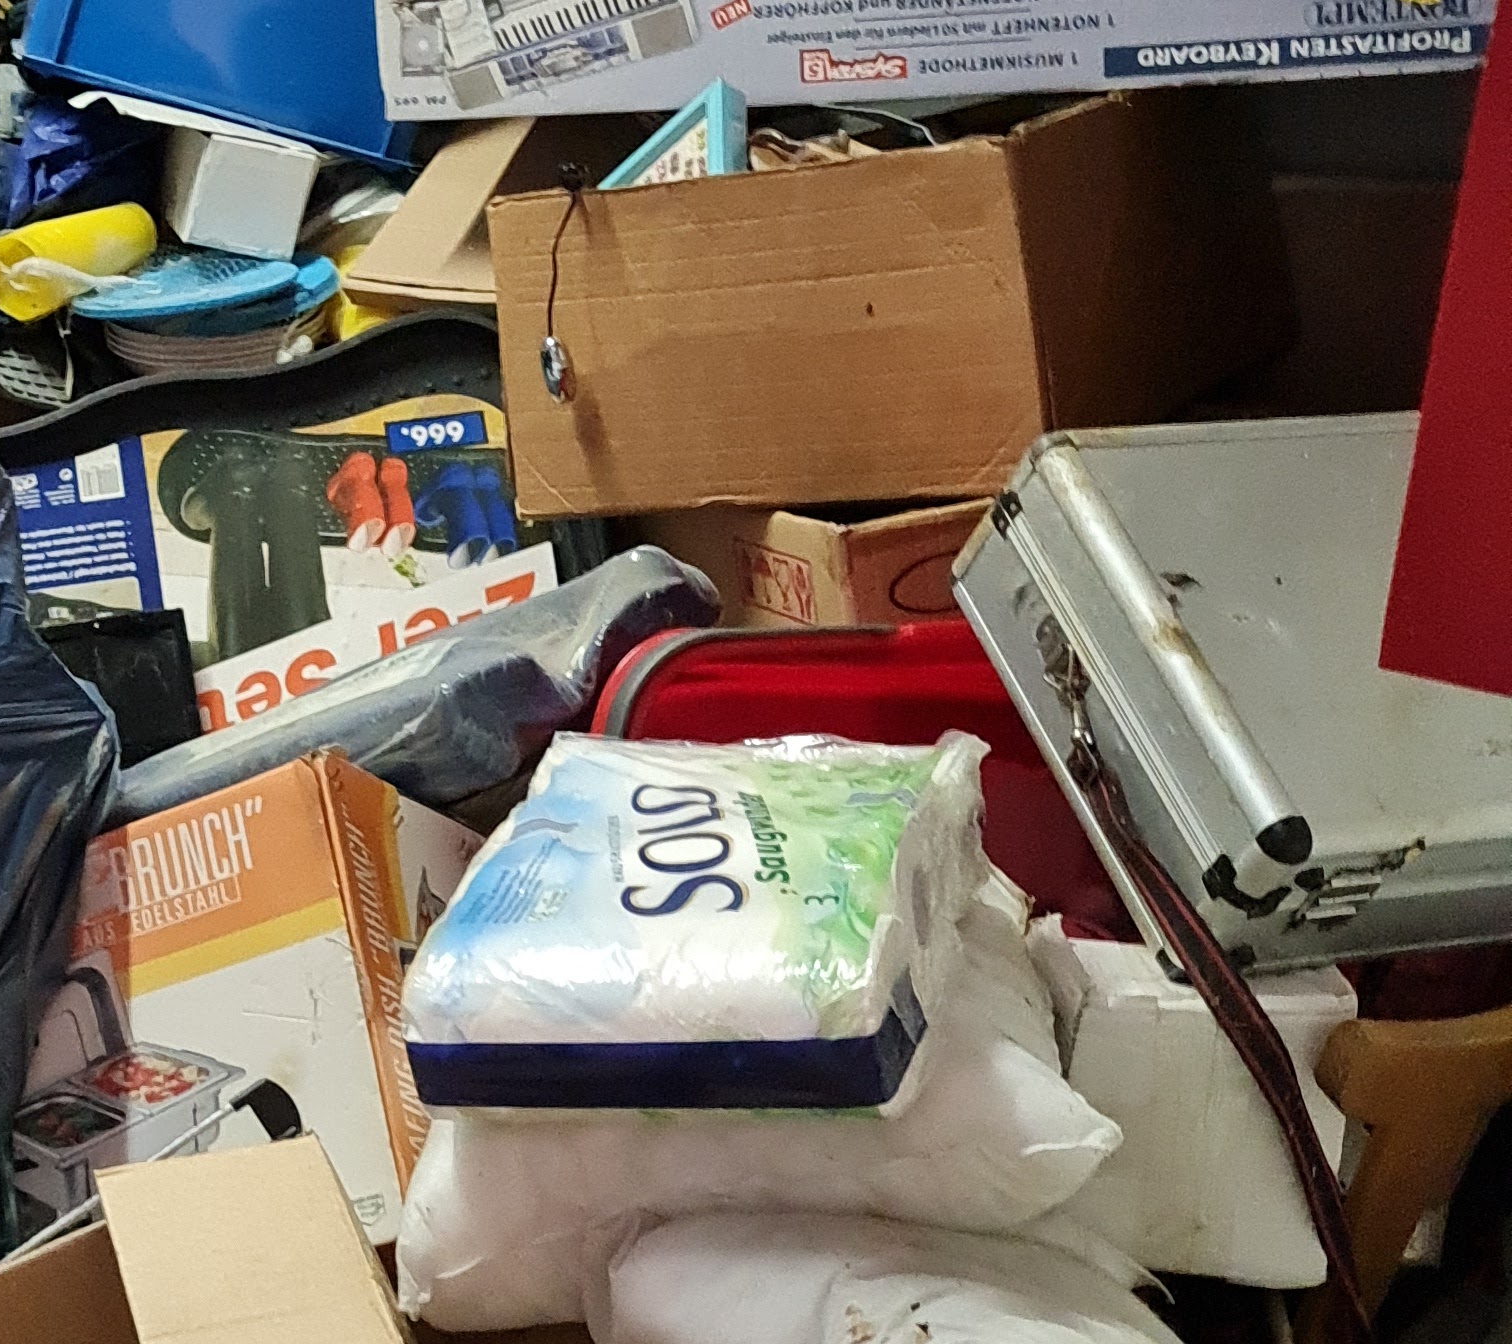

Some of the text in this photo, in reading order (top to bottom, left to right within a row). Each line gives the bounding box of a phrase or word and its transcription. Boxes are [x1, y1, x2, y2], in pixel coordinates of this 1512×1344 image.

[991, 14, 1100, 36] NOTENHEFT
[919, 50, 1064, 75] MUSIKMETHODE
[130, 882, 231, 933] EDELSTAHL
